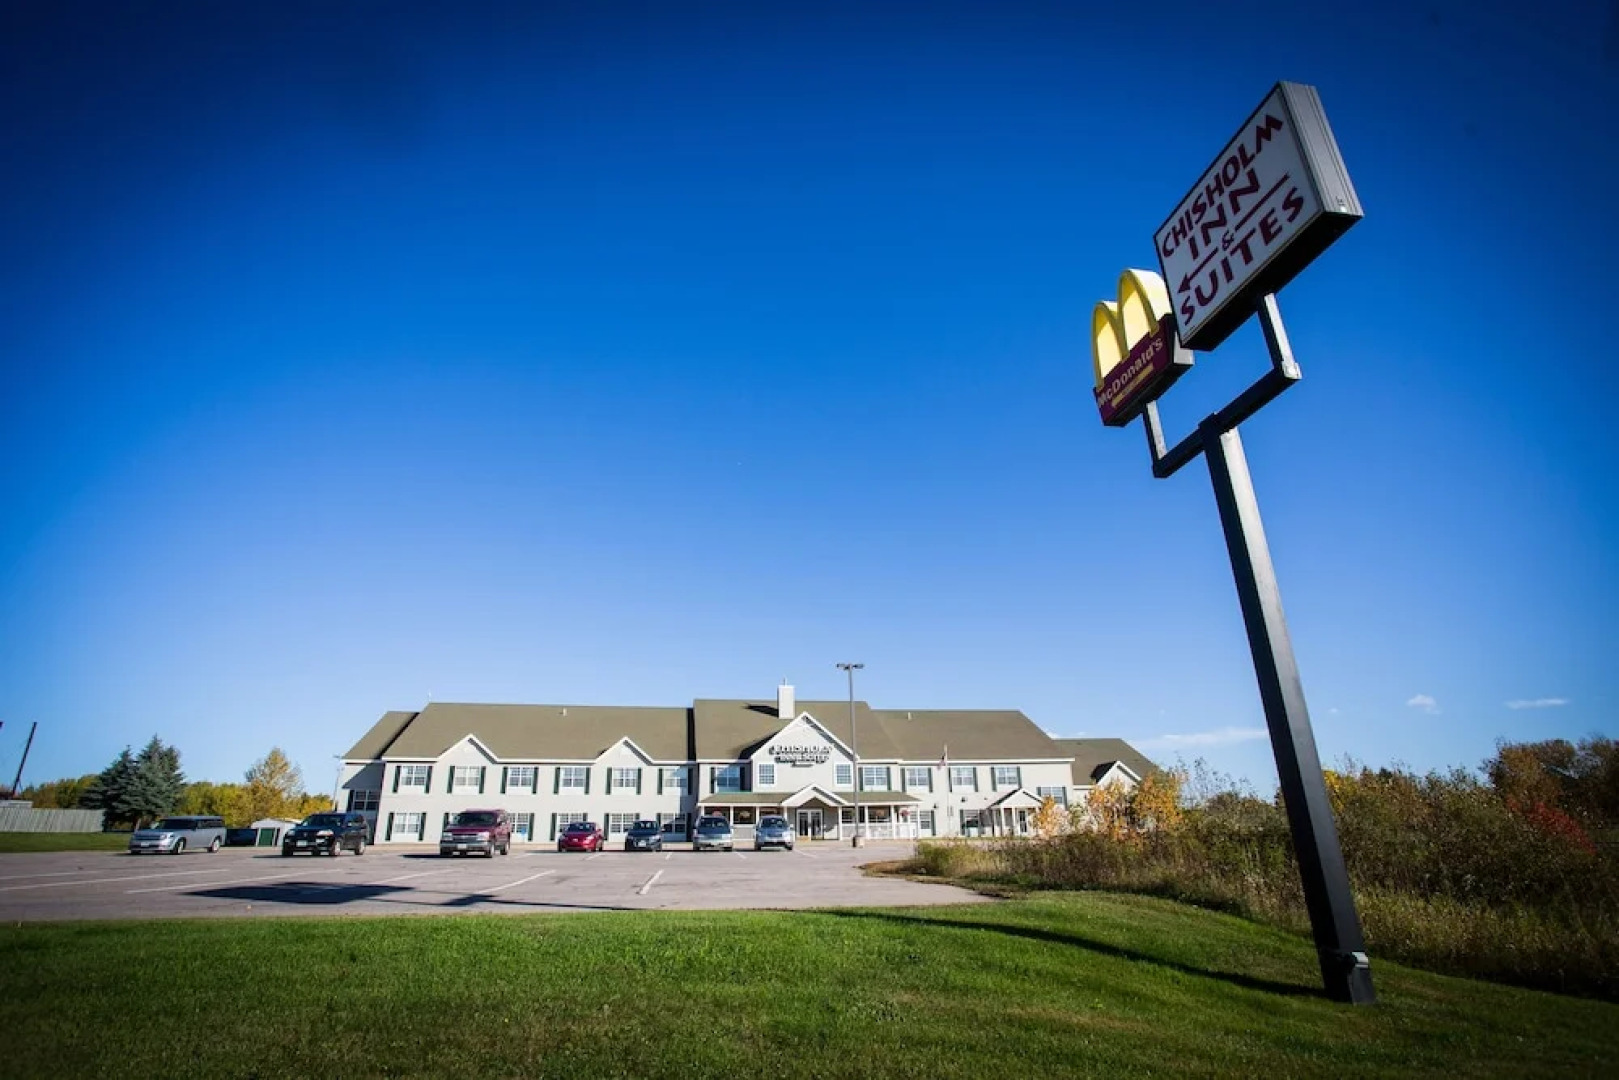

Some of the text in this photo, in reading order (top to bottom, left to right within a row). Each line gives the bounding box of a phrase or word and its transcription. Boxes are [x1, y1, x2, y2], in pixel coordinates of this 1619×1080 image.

[1162, 115, 1283, 258] CHISHOLM
[1187, 168, 1260, 260] INN
[1179, 186, 1305, 326] SUITES
[1221, 231, 1235, 252] &
[1098, 338, 1163, 407] McDonald's
